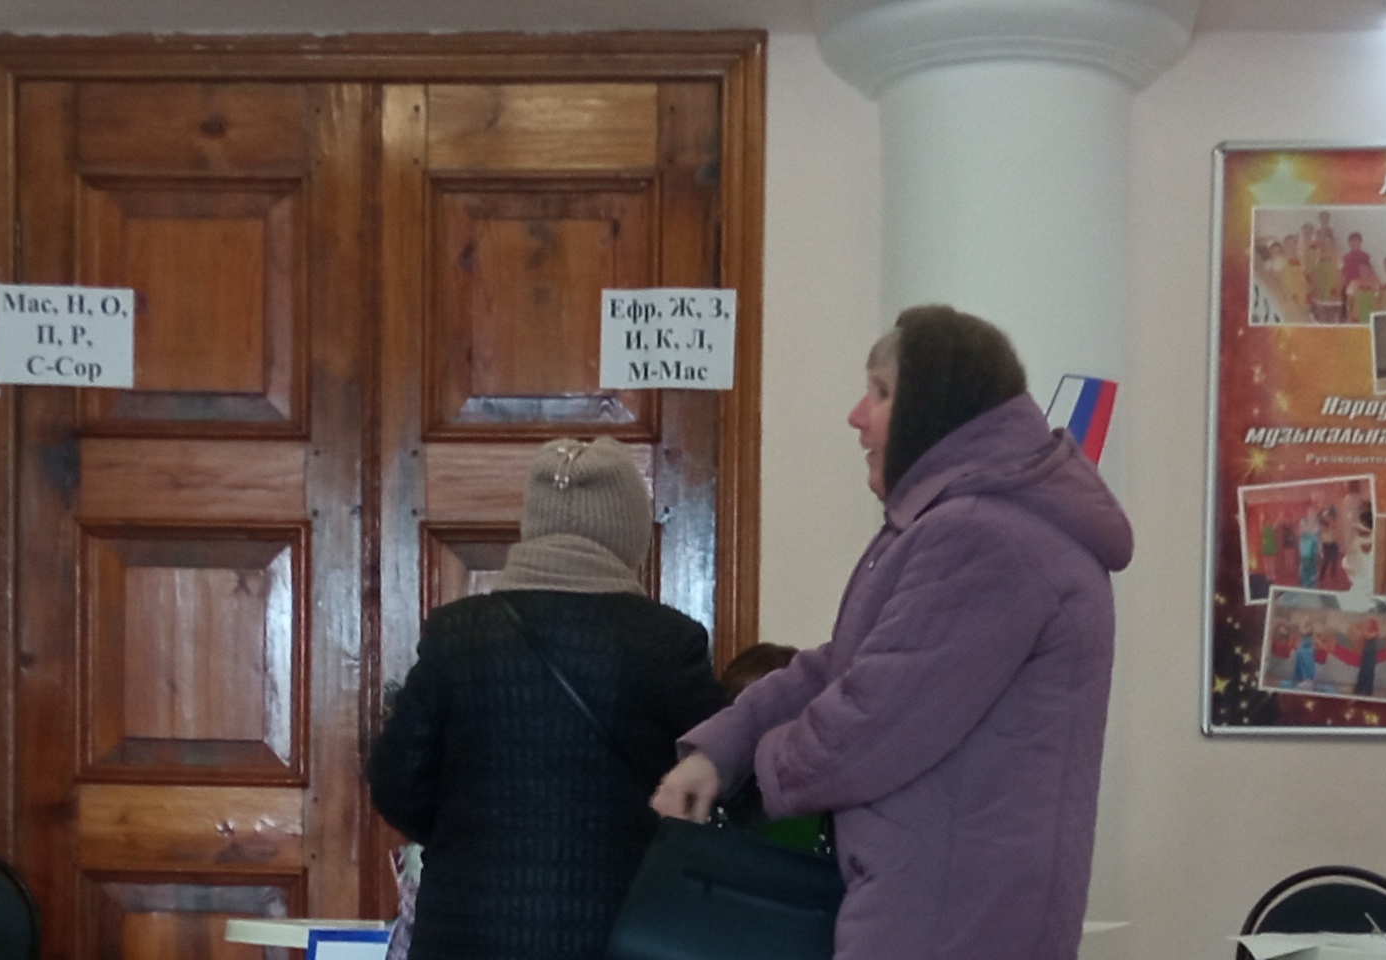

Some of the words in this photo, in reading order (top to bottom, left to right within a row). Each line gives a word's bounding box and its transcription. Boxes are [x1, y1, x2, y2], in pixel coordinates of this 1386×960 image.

[2, 292, 59, 314] Мас,
[67, 294, 93, 316] Н,
[100, 295, 128, 318] О,
[609, 298, 662, 324] Ефр,
[669, 296, 702, 319] Ж,
[709, 296, 730, 319] З,
[37, 324, 63, 347] П,
[71, 325, 93, 347] Р,
[625, 330, 649, 351] И,
[656, 328, 679, 350] К,
[686, 328, 712, 351] Л,
[26, 355, 102, 382] С-Сор
[628, 360, 708, 381] М-Мас
